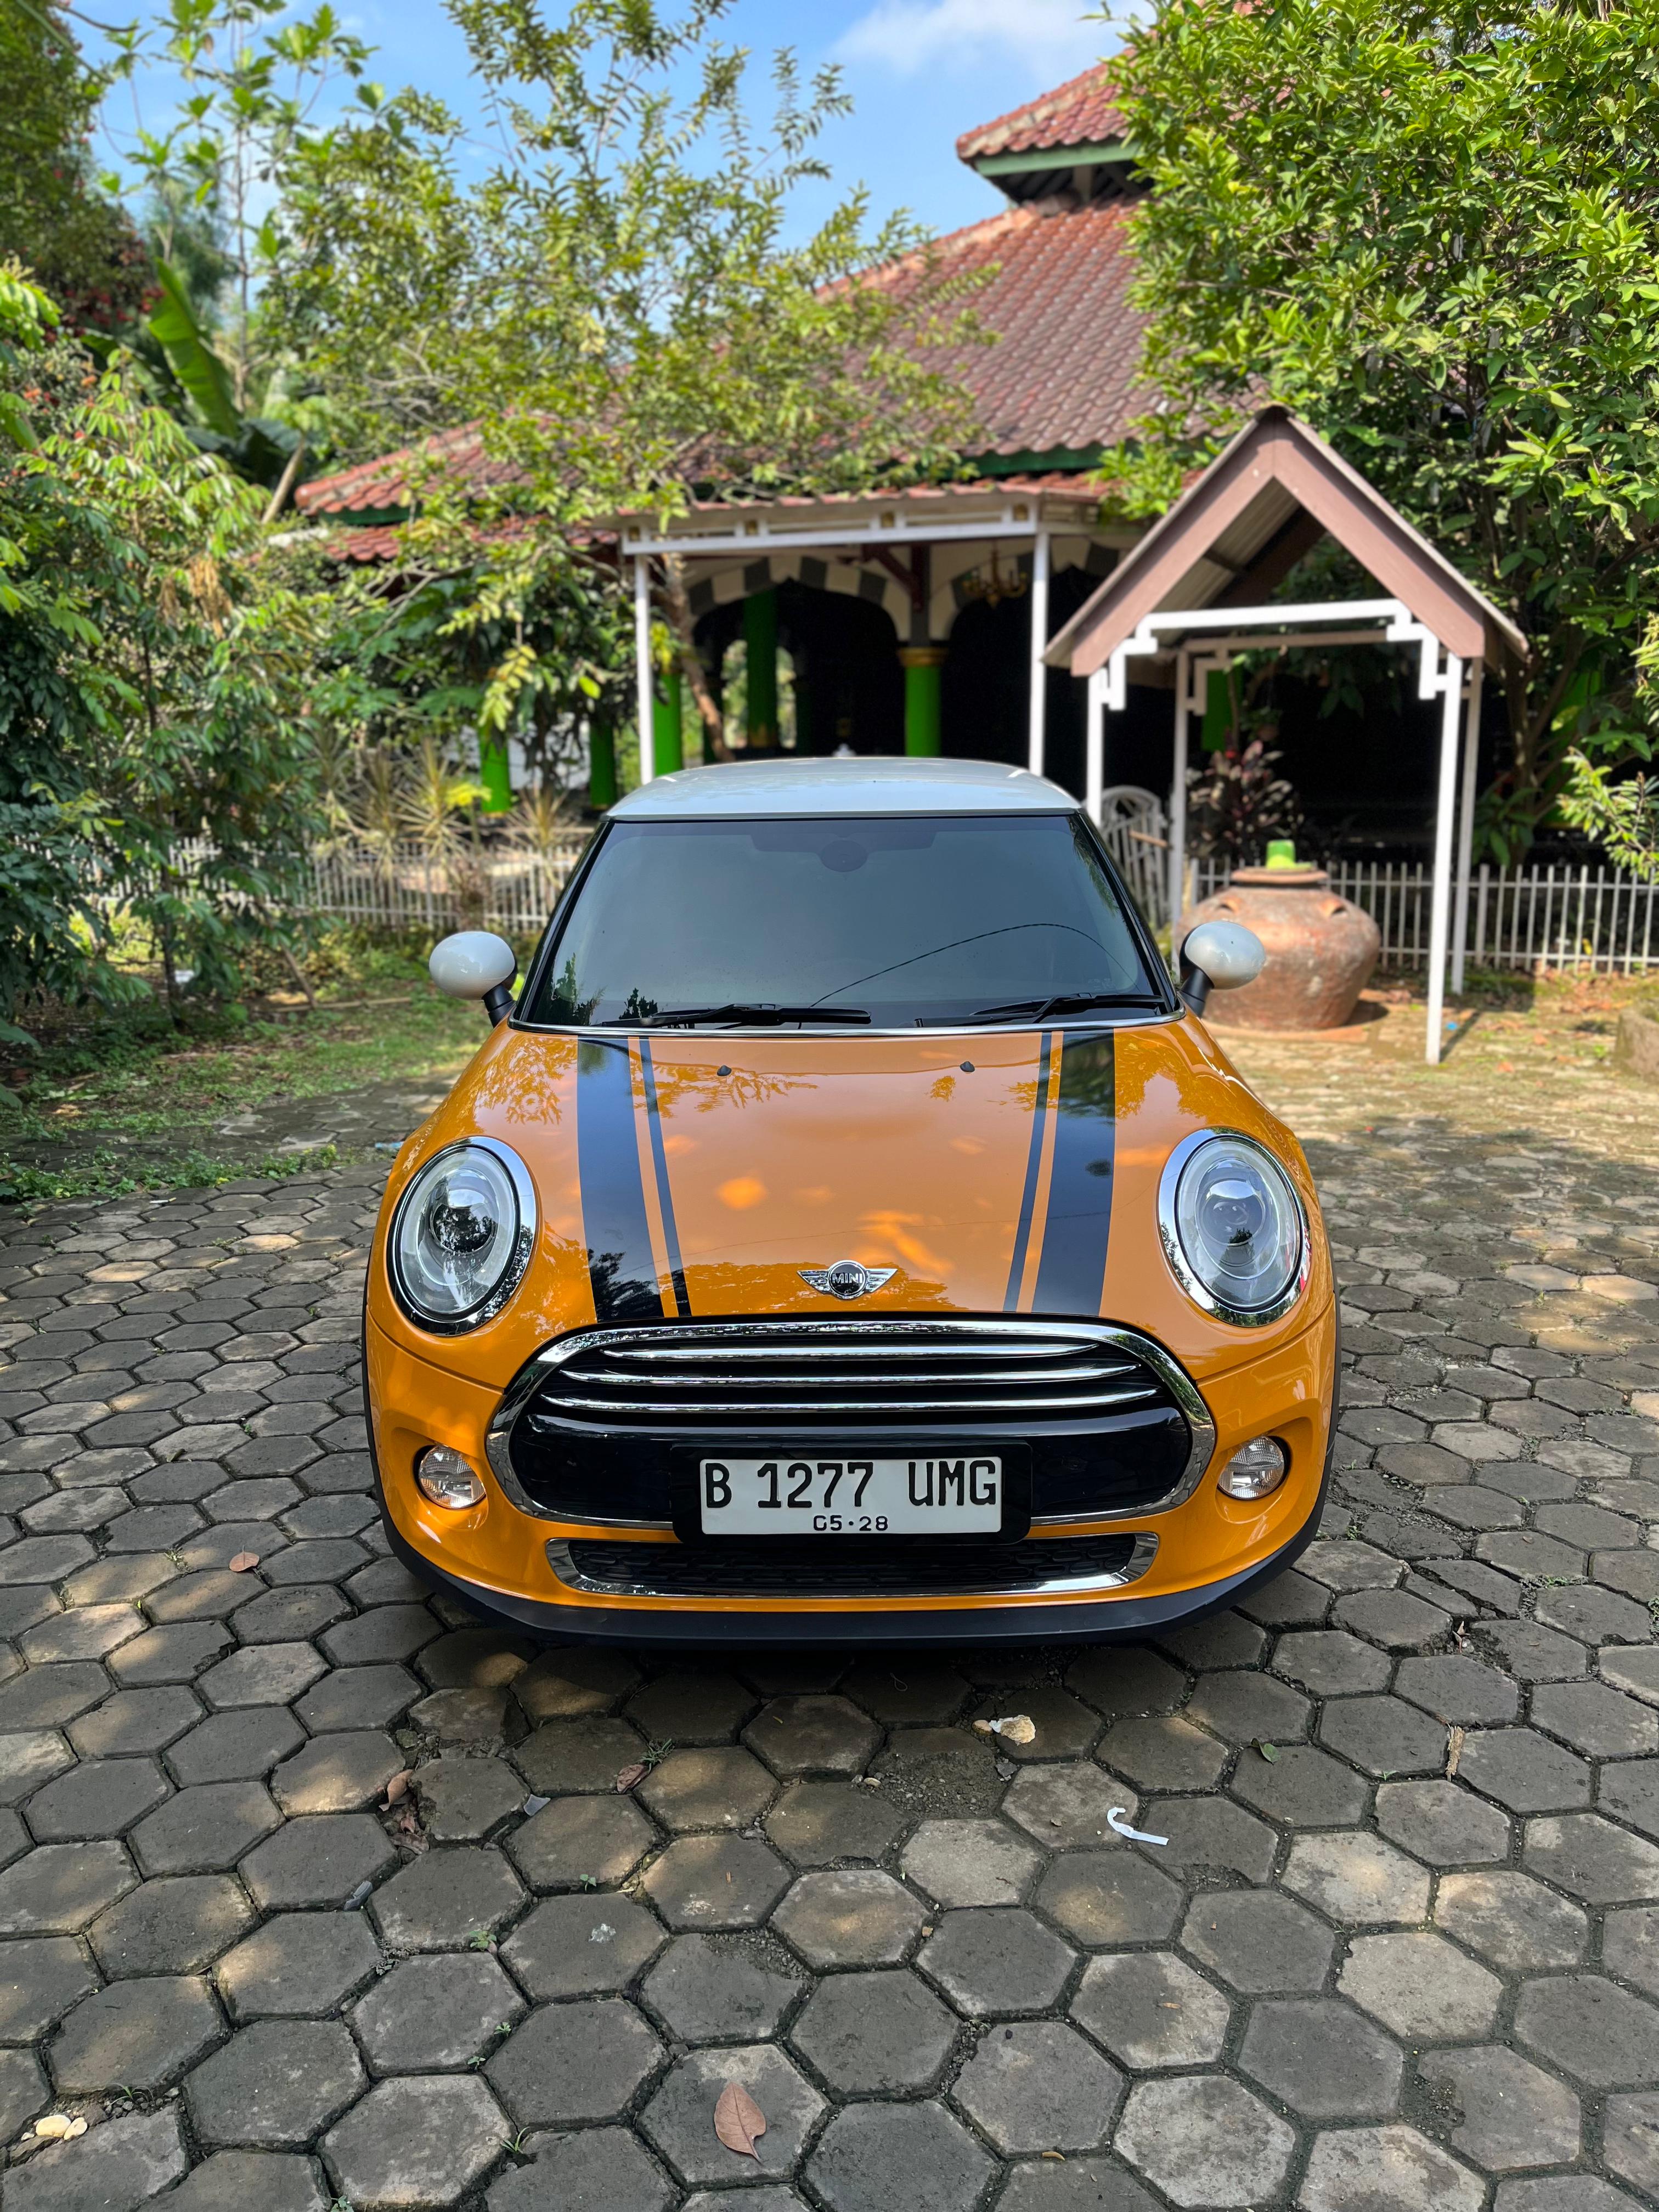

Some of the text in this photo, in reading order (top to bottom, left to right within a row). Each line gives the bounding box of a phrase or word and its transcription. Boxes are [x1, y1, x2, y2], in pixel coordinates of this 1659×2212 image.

[832, 1273, 863, 1284] MINI
[706, 1460, 996, 1508] B 1277 UMG
